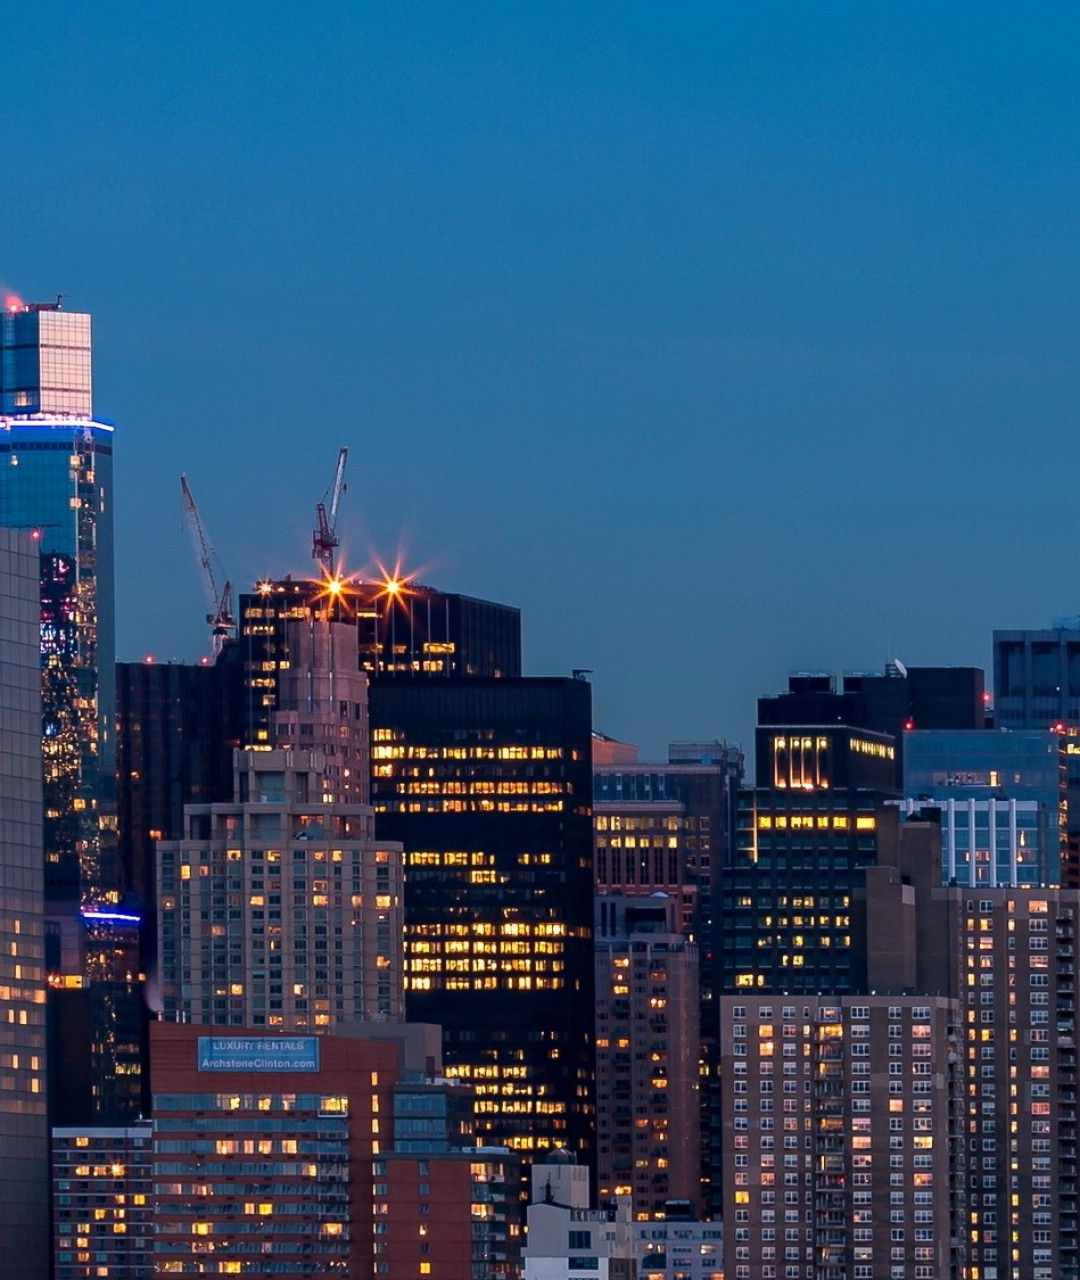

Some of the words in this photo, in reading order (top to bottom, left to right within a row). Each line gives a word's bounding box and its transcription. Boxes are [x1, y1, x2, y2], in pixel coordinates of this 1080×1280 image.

[213, 1042, 254, 1050] LUXURY
[257, 1041, 304, 1050] RENTALS
[202, 1059, 315, 1068] ArchstoneClinton.com
